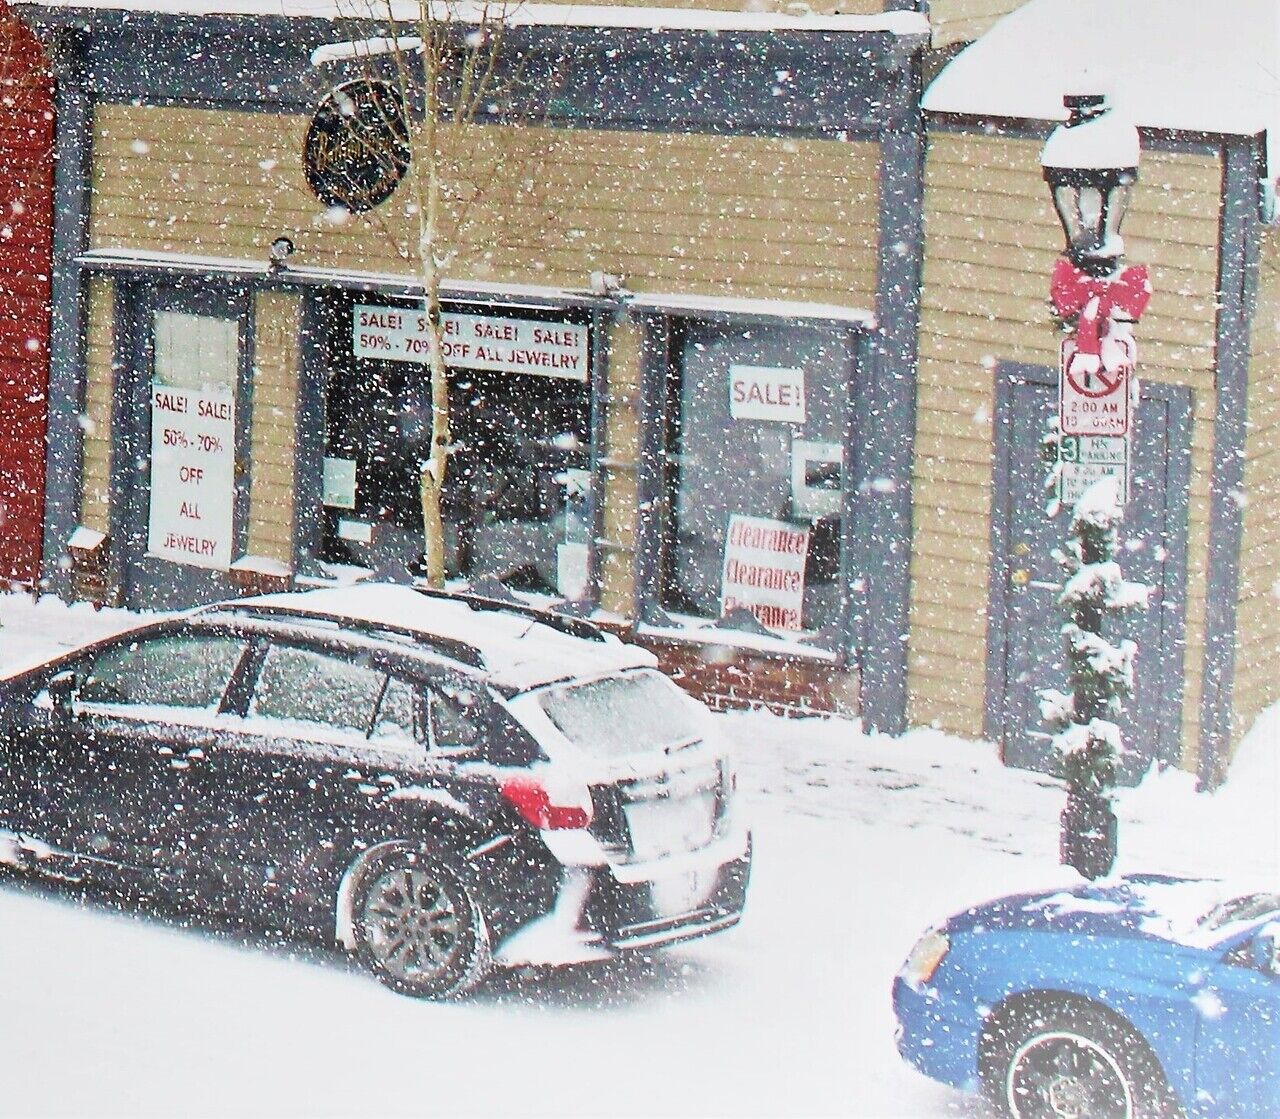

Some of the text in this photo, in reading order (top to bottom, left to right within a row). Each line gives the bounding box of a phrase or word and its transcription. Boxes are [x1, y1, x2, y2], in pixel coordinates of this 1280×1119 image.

[359, 312, 403, 330] SALE!
[474, 323, 519, 342] SALE!
[533, 329, 579, 348] SALE!
[359, 334, 391, 350] 50%
[475, 345, 503, 362] ALL
[508, 350, 580, 370] JEWELRY
[732, 380, 801, 407] SALE!
[155, 393, 232, 421] SALE! SALE!
[1102, 403, 1118, 413] AM
[163, 428, 188, 449] 50%
[197, 434, 223, 453] 70%
[1063, 437, 1078, 461] 3
[179, 466, 204, 485] OFF
[179, 501, 202, 520] ALL
[163, 532, 218, 557] JEWELRY
[729, 520, 806, 554] Clearance
[725, 558, 802, 592] Clearance
